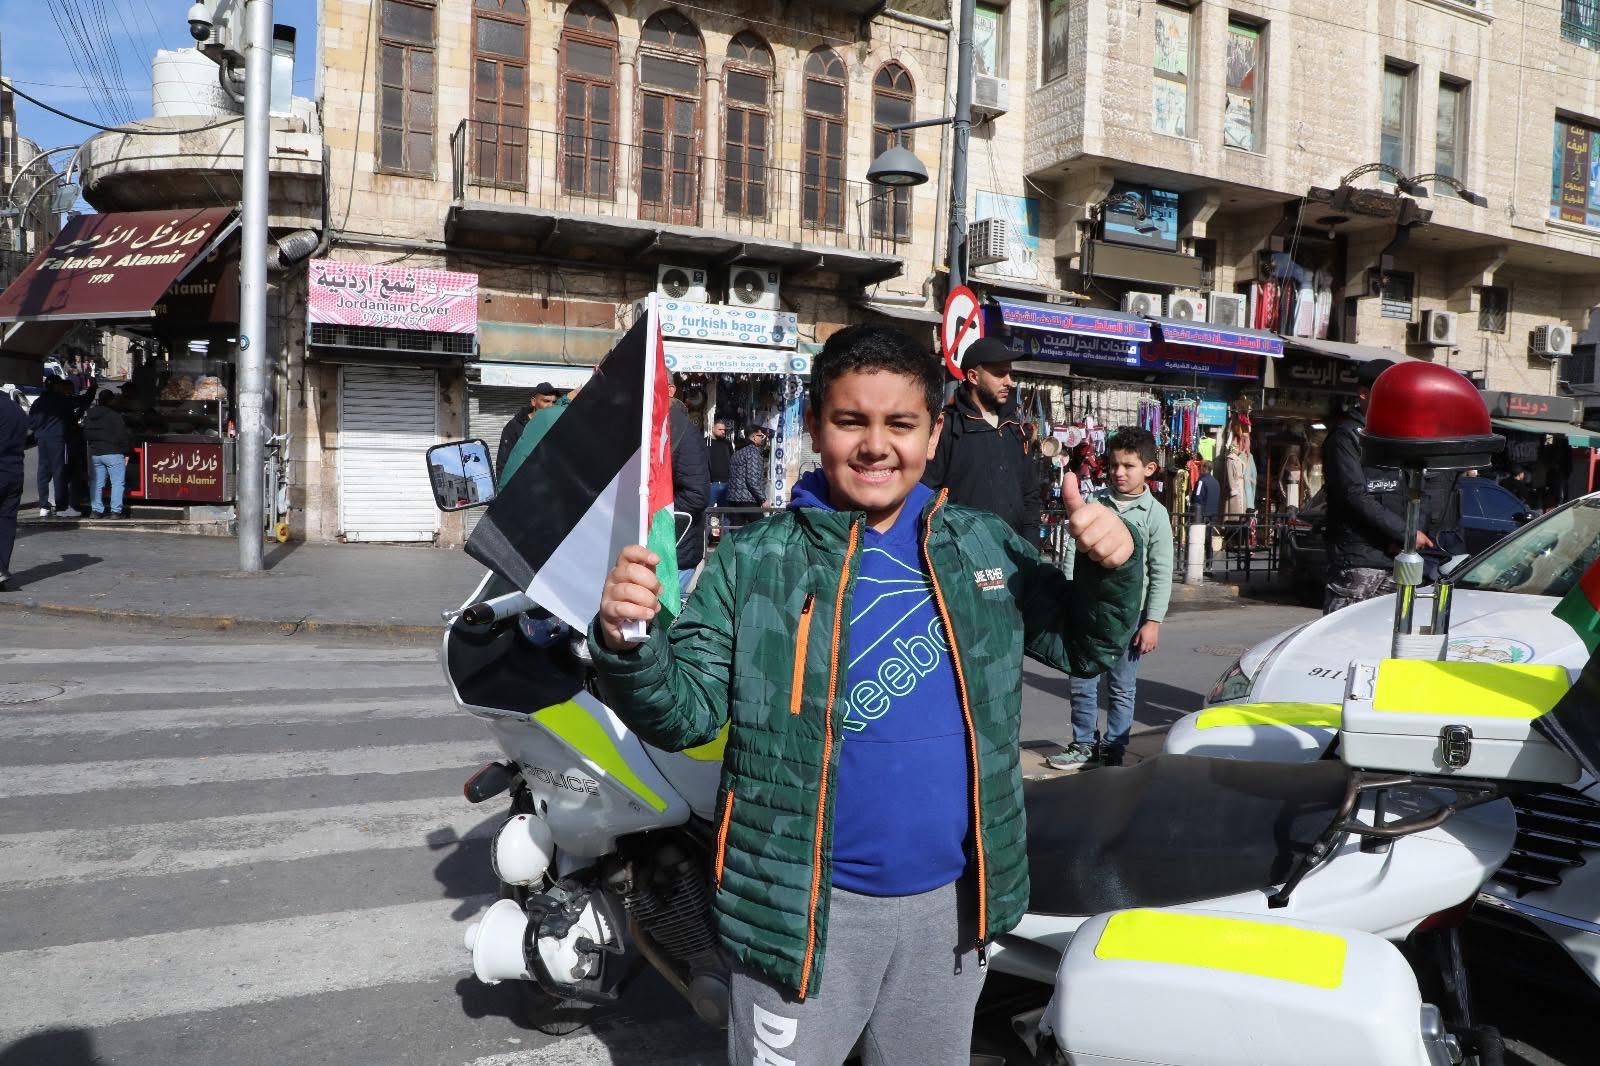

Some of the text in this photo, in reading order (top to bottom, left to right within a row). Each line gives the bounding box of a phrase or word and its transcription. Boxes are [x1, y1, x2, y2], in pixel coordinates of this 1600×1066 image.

[54, 219, 211, 254] فلافل الأمير
[36, 250, 185, 271] Falafel Alamir
[87, 273, 114, 284] 1978
[317, 265, 374, 294] أردنية
[380, 271, 416, 299] شمغ
[336, 297, 450, 316] Jordanian Cover
[681, 315, 767, 333] turkish bazar
[1043, 335, 1076, 349] الميت
[1076, 335, 1100, 353] البحر
[706, 359, 765, 368] turkish bazar
[152, 449, 218, 472] فلافل الأمير
[152, 473, 217, 485] Falafel Alamir
[842, 615, 952, 732] eebo
[521, 762, 601, 797] POLICE
